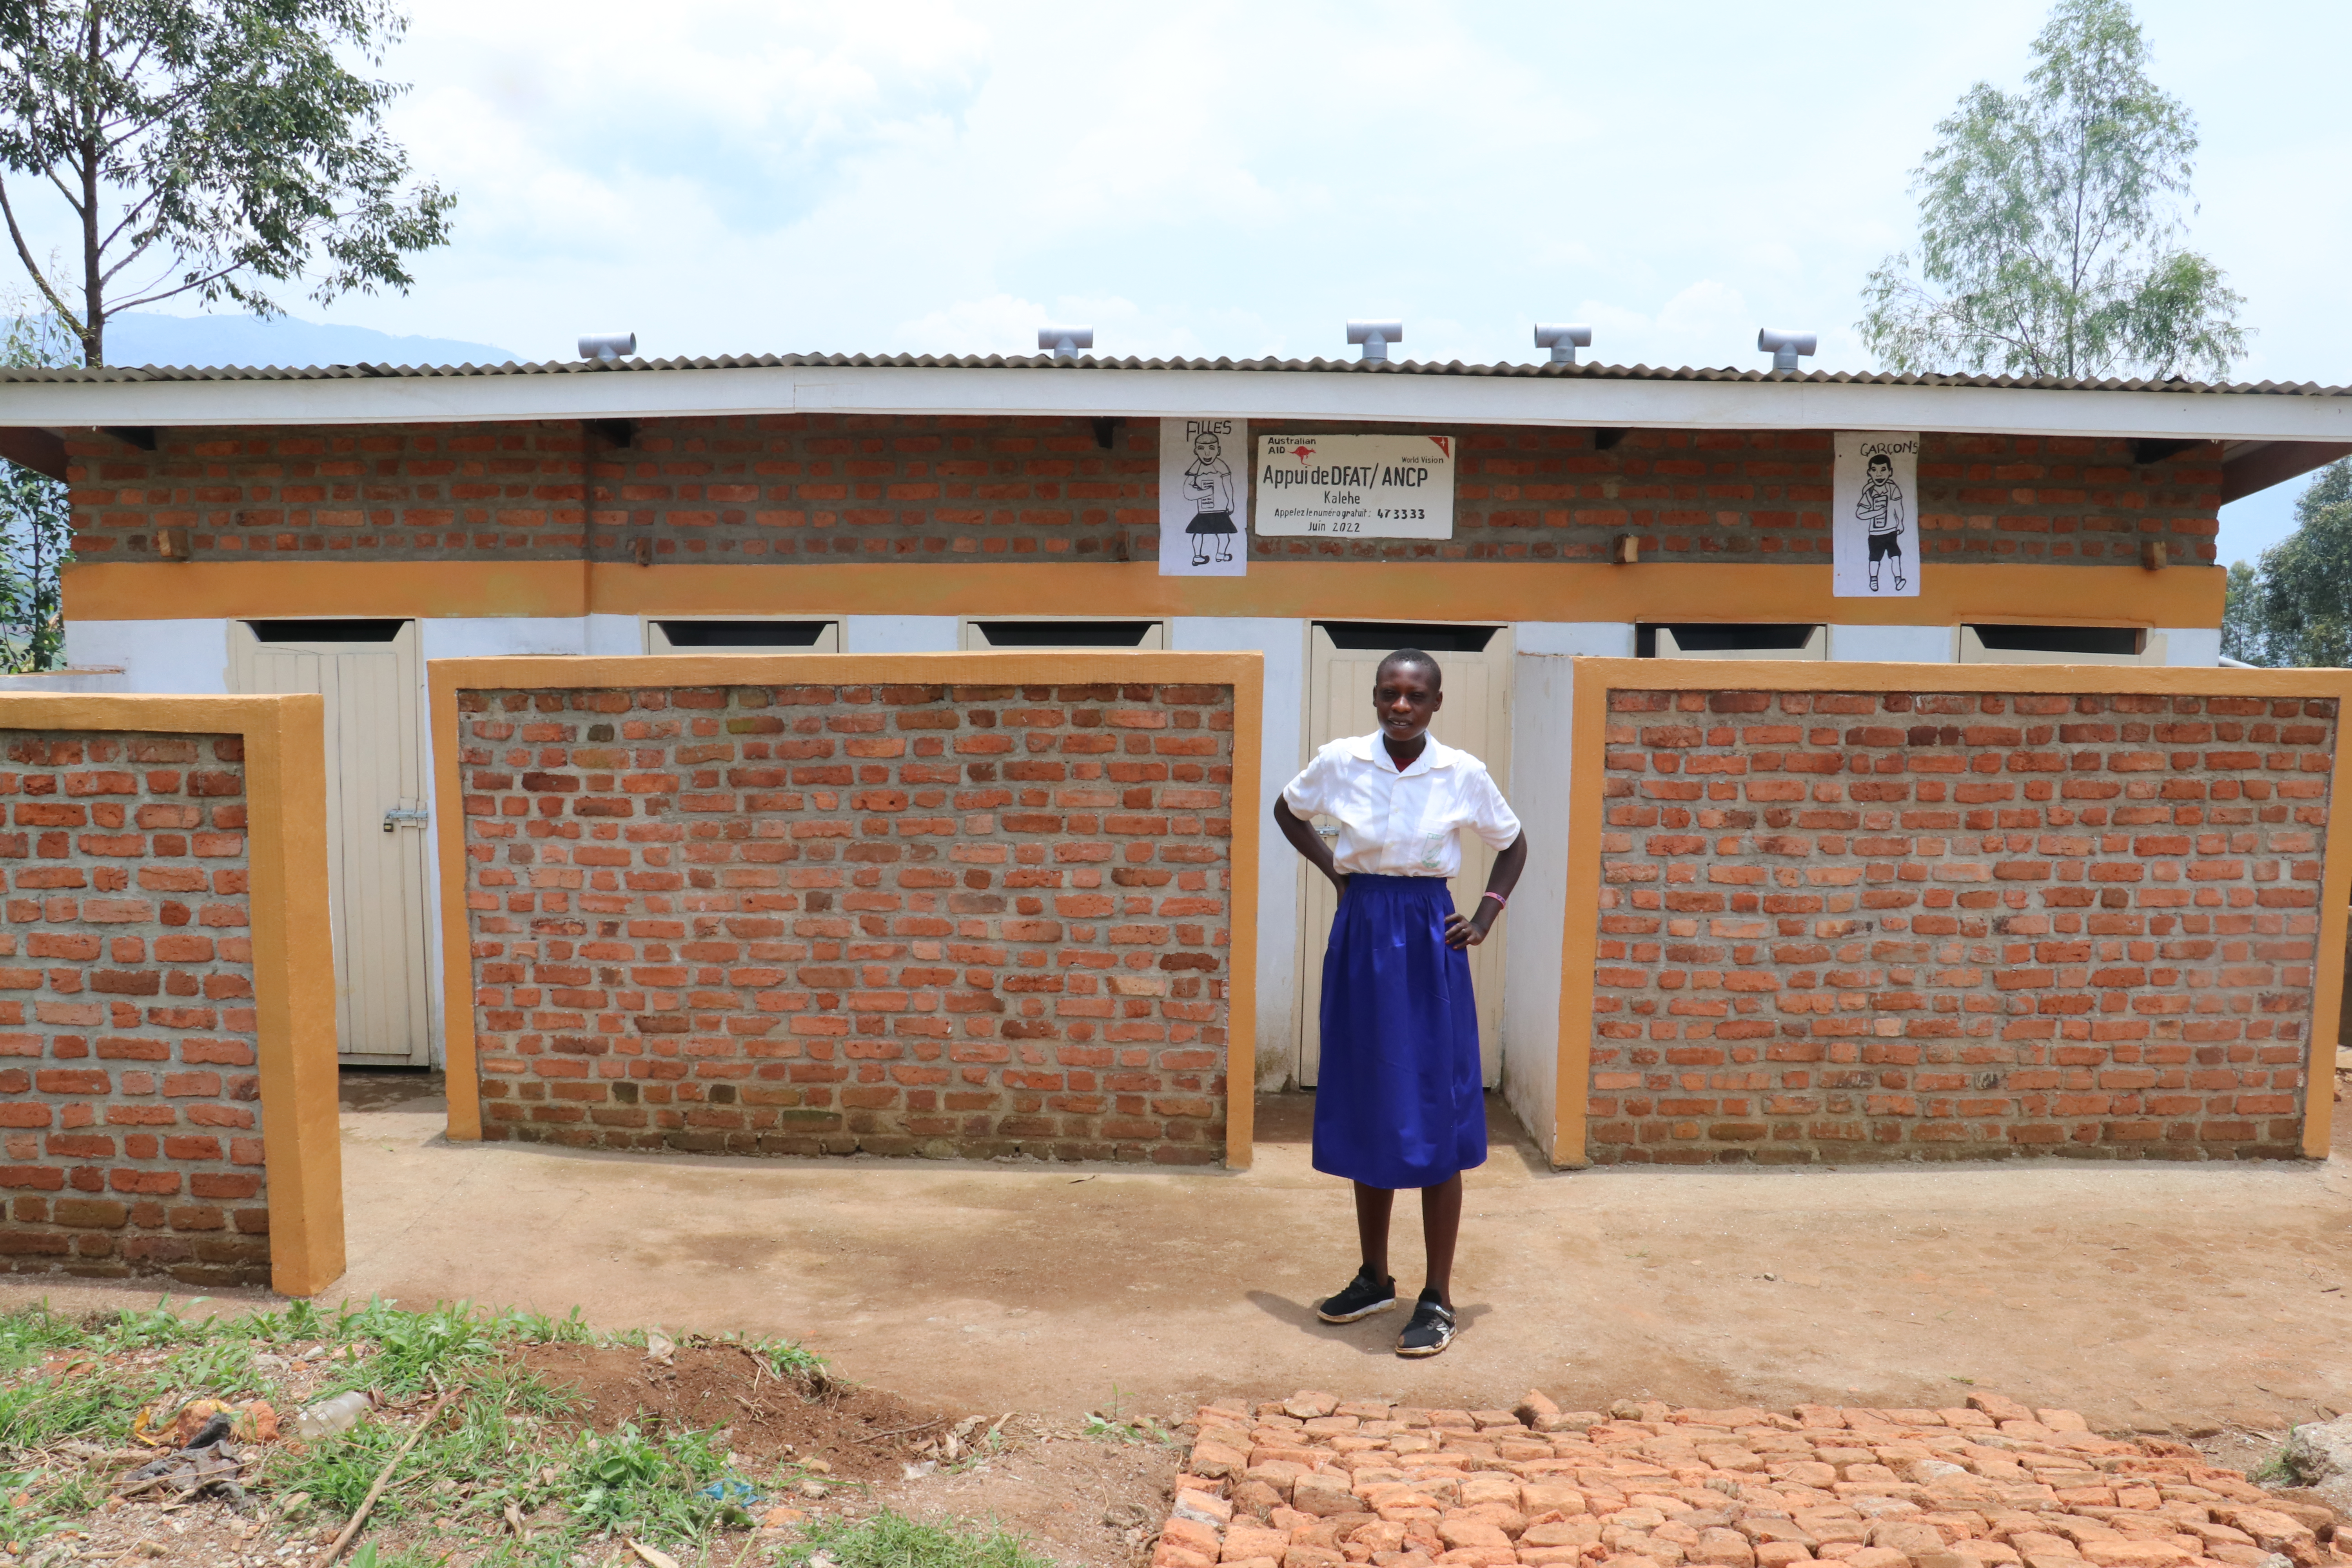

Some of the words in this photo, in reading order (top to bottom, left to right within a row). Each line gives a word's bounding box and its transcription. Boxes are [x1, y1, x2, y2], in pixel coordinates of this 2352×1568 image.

[1187, 420, 1231, 442] FILLES
[1263, 465, 1308, 489] Appui
[1311, 466, 1329, 485] de
[1324, 491, 1360, 504] Kalehe
[1274, 508, 1305, 518] Appelez
[1306, 508, 1312, 517] le
[1308, 520, 1325, 531] Juin
[1333, 523, 1360, 532] 2022
